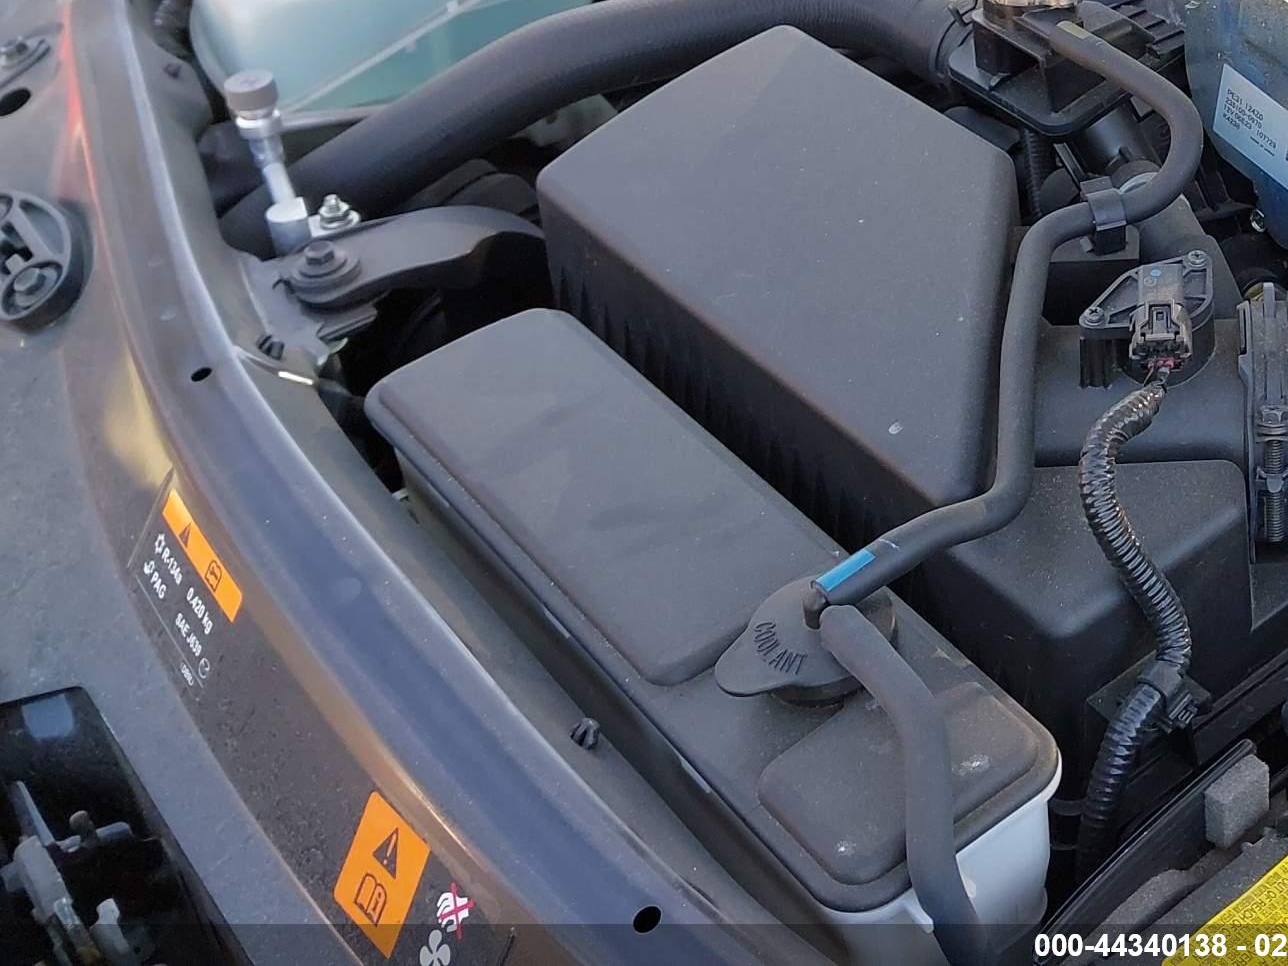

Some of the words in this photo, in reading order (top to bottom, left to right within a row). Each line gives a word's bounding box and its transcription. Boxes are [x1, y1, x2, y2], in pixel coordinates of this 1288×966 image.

[151, 571, 167, 599] PAG
[175, 612, 191, 637] SAE
[161, 547, 183, 585] R-134a
[202, 611, 213, 634] kg
[753, 620, 809, 675] COOLANT
[1241, 901, 1266, 922] REACH
[1266, 890, 1277, 902] OF
